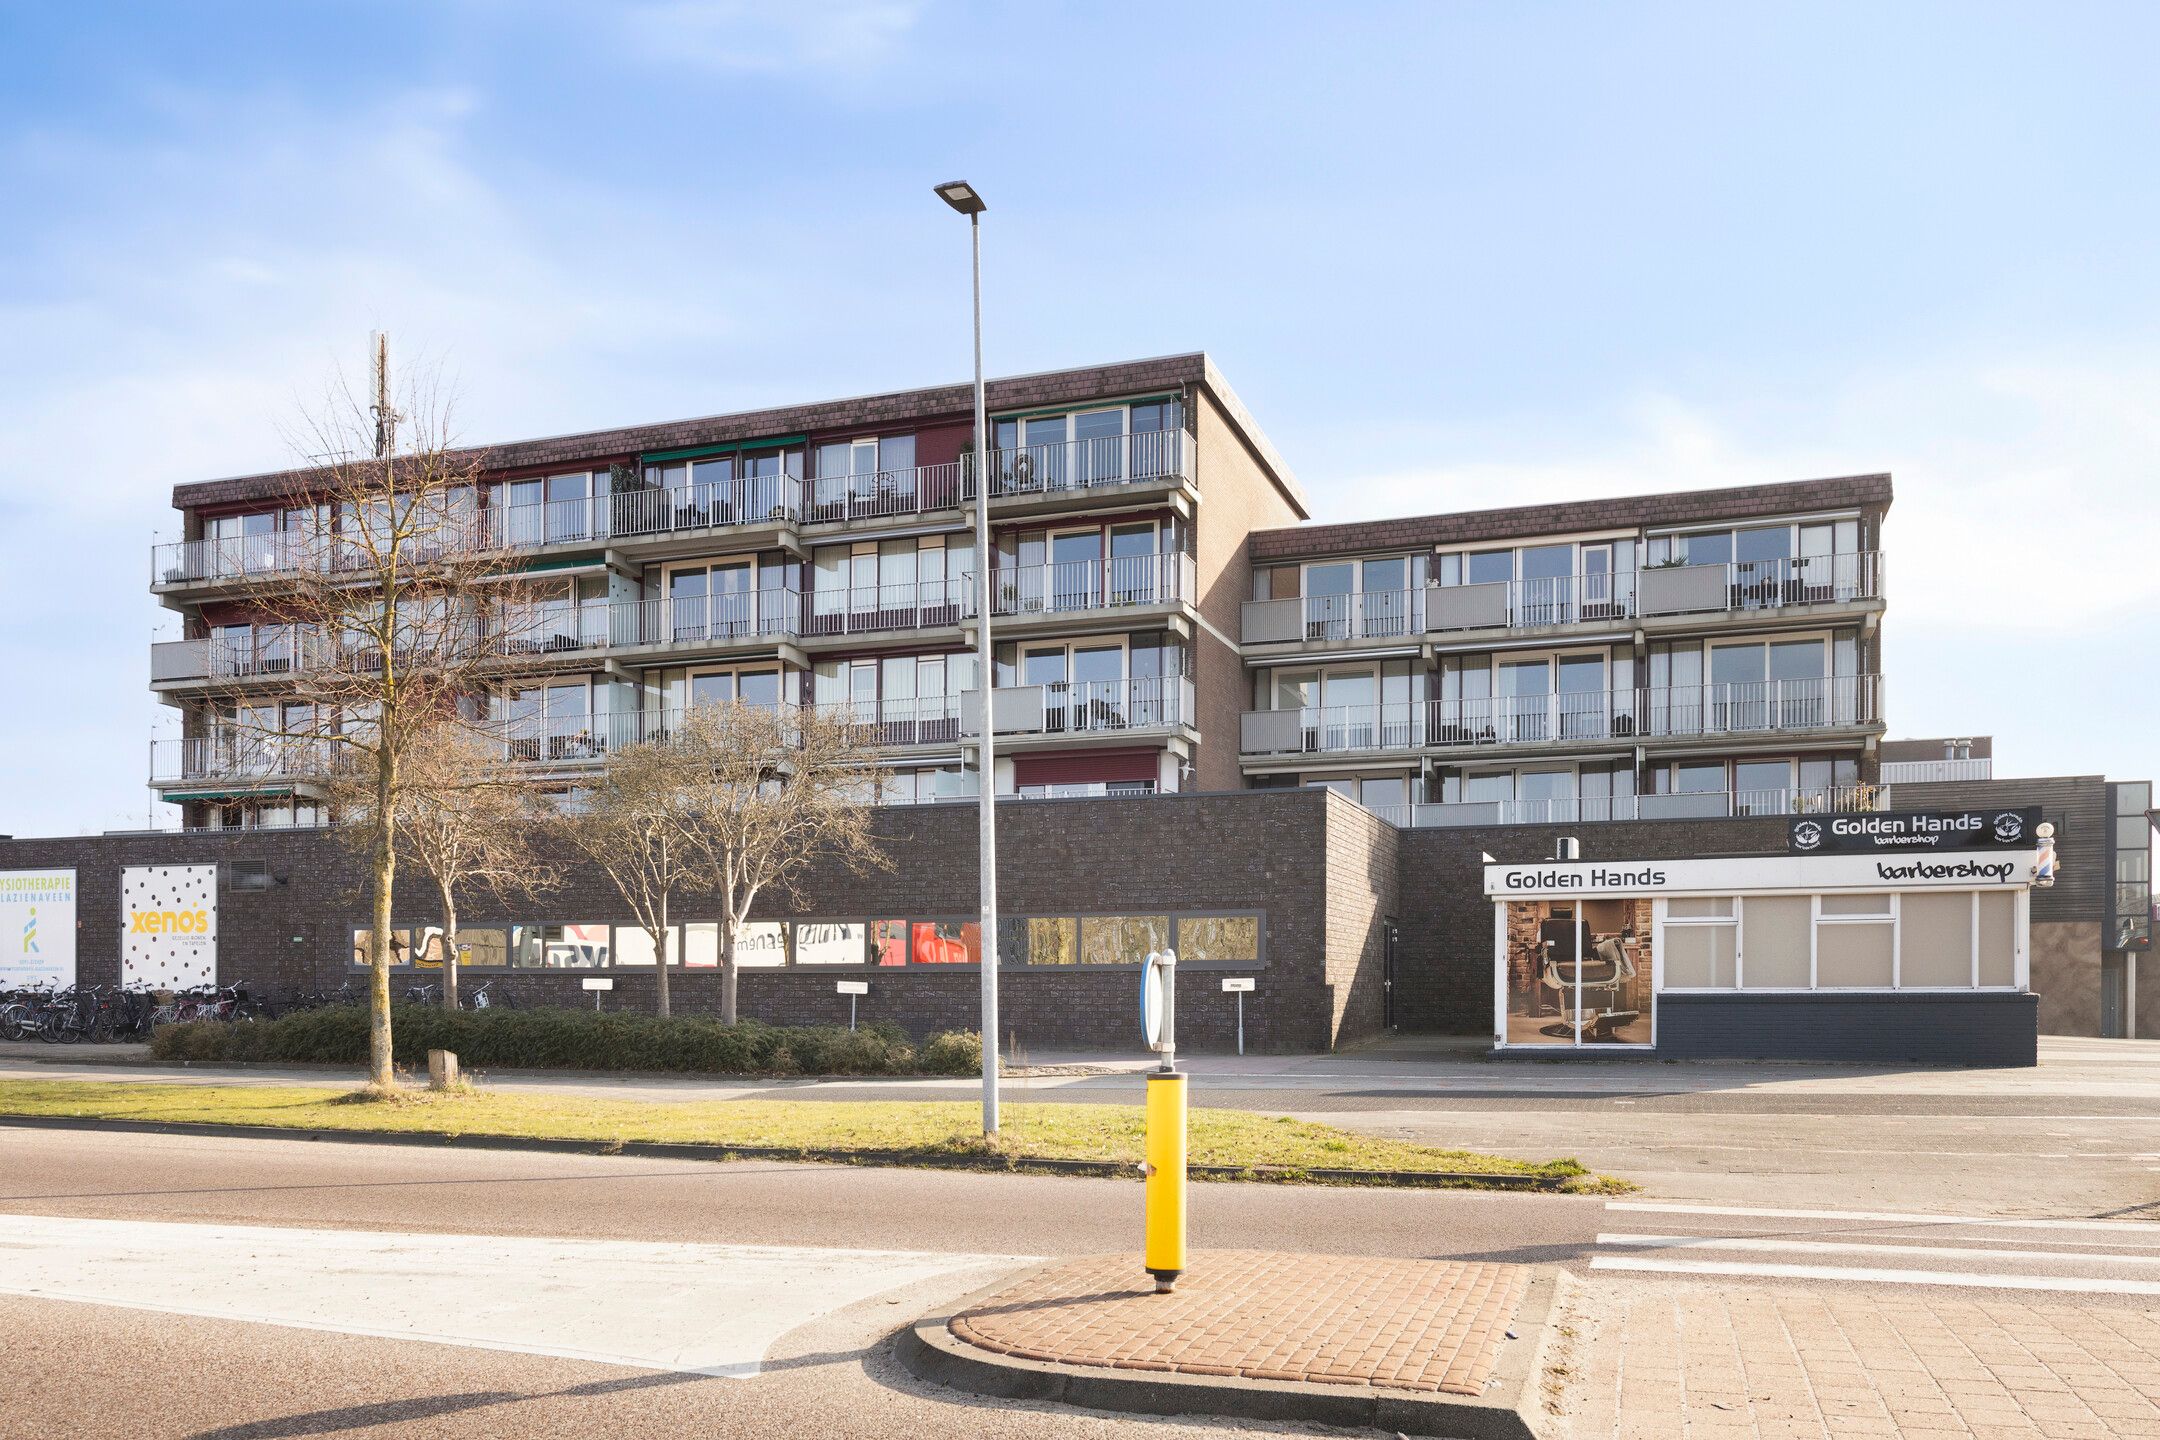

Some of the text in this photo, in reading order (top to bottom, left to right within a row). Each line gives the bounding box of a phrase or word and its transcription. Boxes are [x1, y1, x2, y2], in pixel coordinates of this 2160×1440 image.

[1832, 814, 1982, 834] Golden Hands
[1874, 834, 1939, 845] barbershop
[1505, 867, 1666, 889] Golden Hands
[1876, 860, 2015, 883] barbershop
[130, 910, 208, 934] xenos
